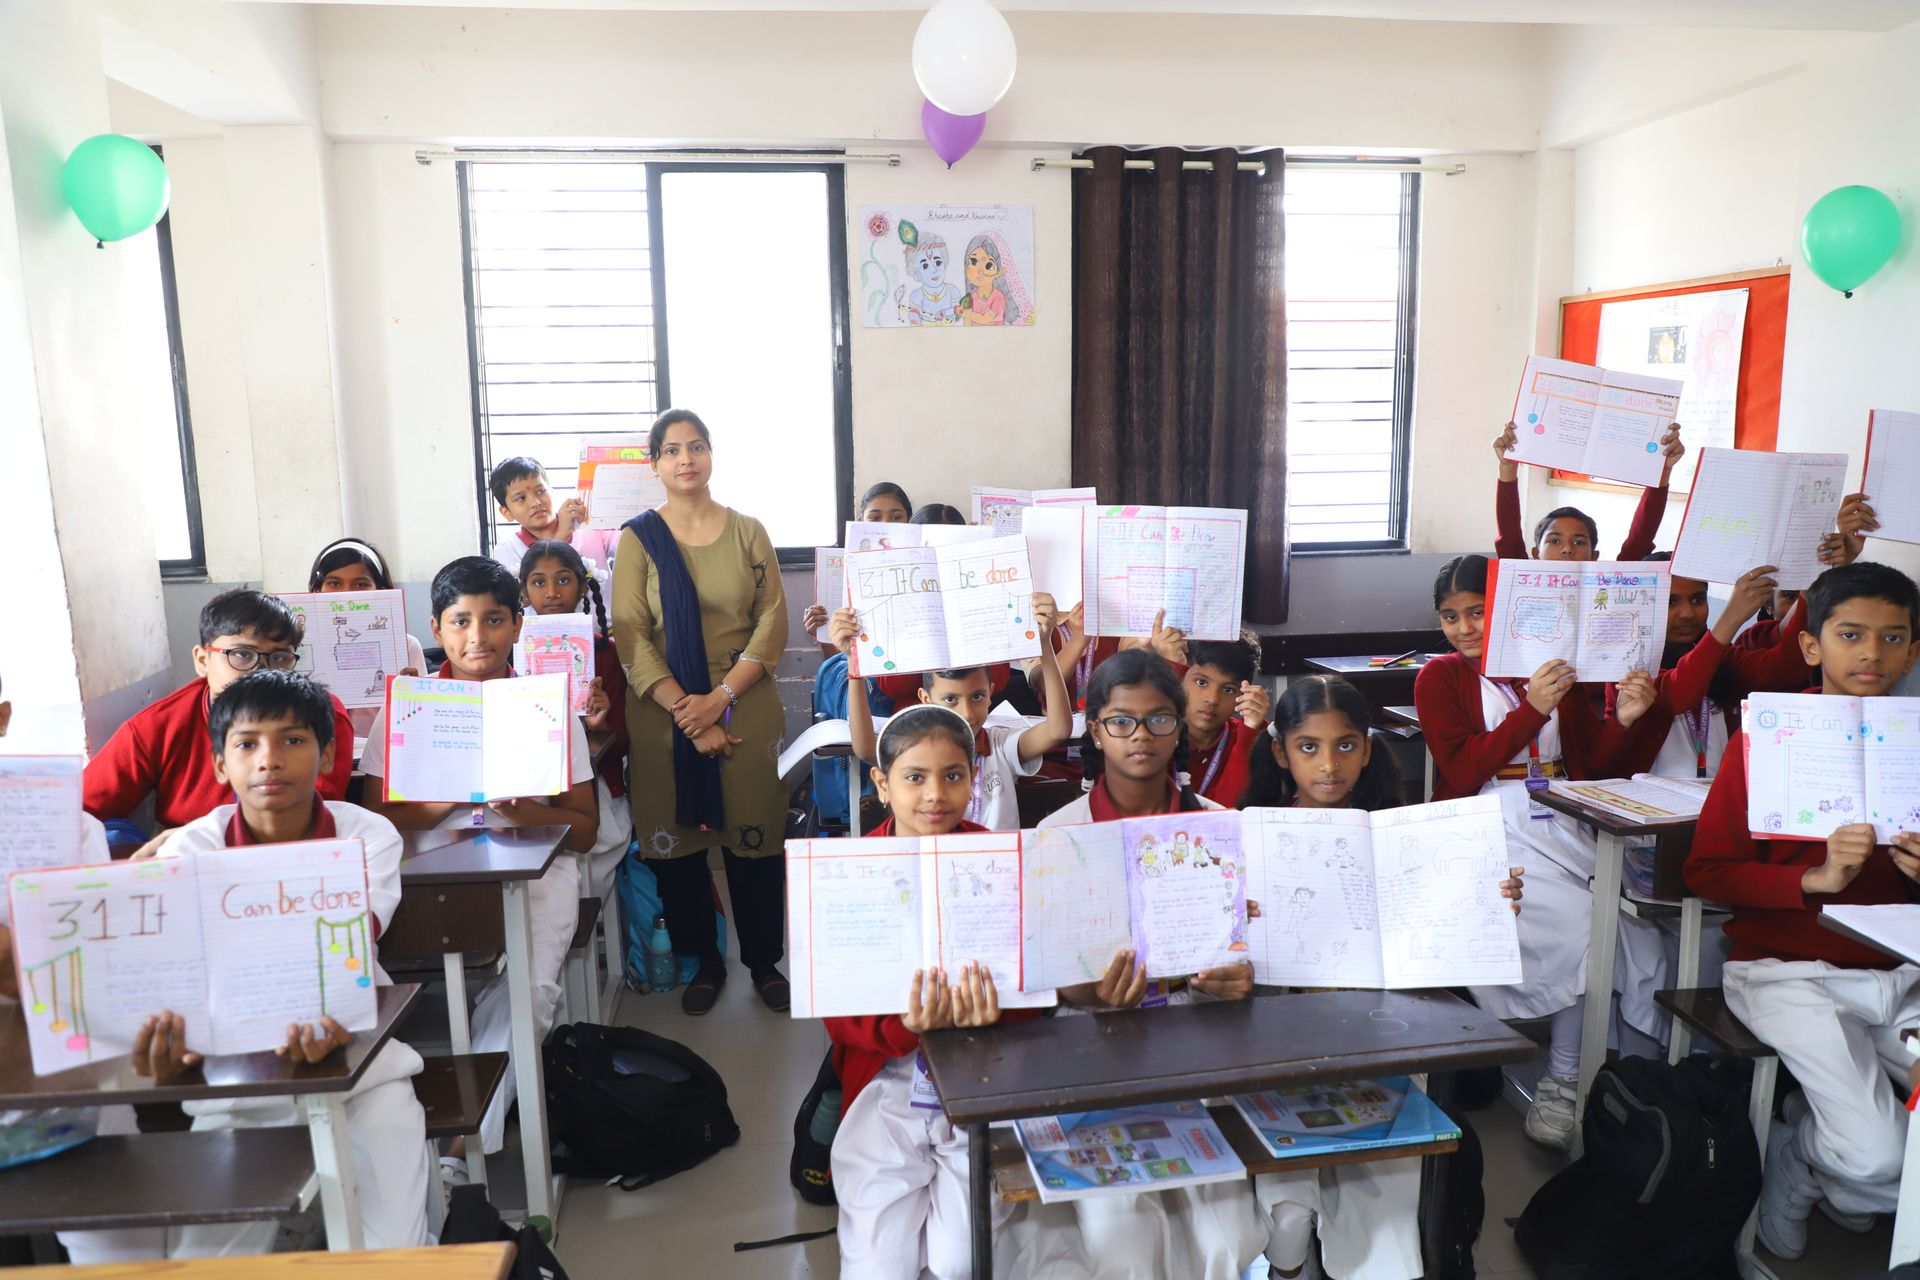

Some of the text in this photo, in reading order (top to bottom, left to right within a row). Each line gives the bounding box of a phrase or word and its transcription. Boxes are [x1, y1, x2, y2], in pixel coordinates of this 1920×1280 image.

[889, 567, 908, 595] It
[909, 566, 941, 593] Can
[958, 560, 978, 590] be
[985, 558, 1019, 585] done
[1596, 572, 1612, 587] Be
[416, 679, 433, 691] IT
[438, 680, 465, 693] CAN
[1783, 711, 1806, 731] It
[1810, 713, 1843, 731] Can
[950, 858, 975, 877] be
[984, 857, 1015, 875] done
[128, 893, 169, 937] It
[220, 883, 272, 920] Can
[278, 879, 305, 915] be
[310, 876, 362, 910] done
